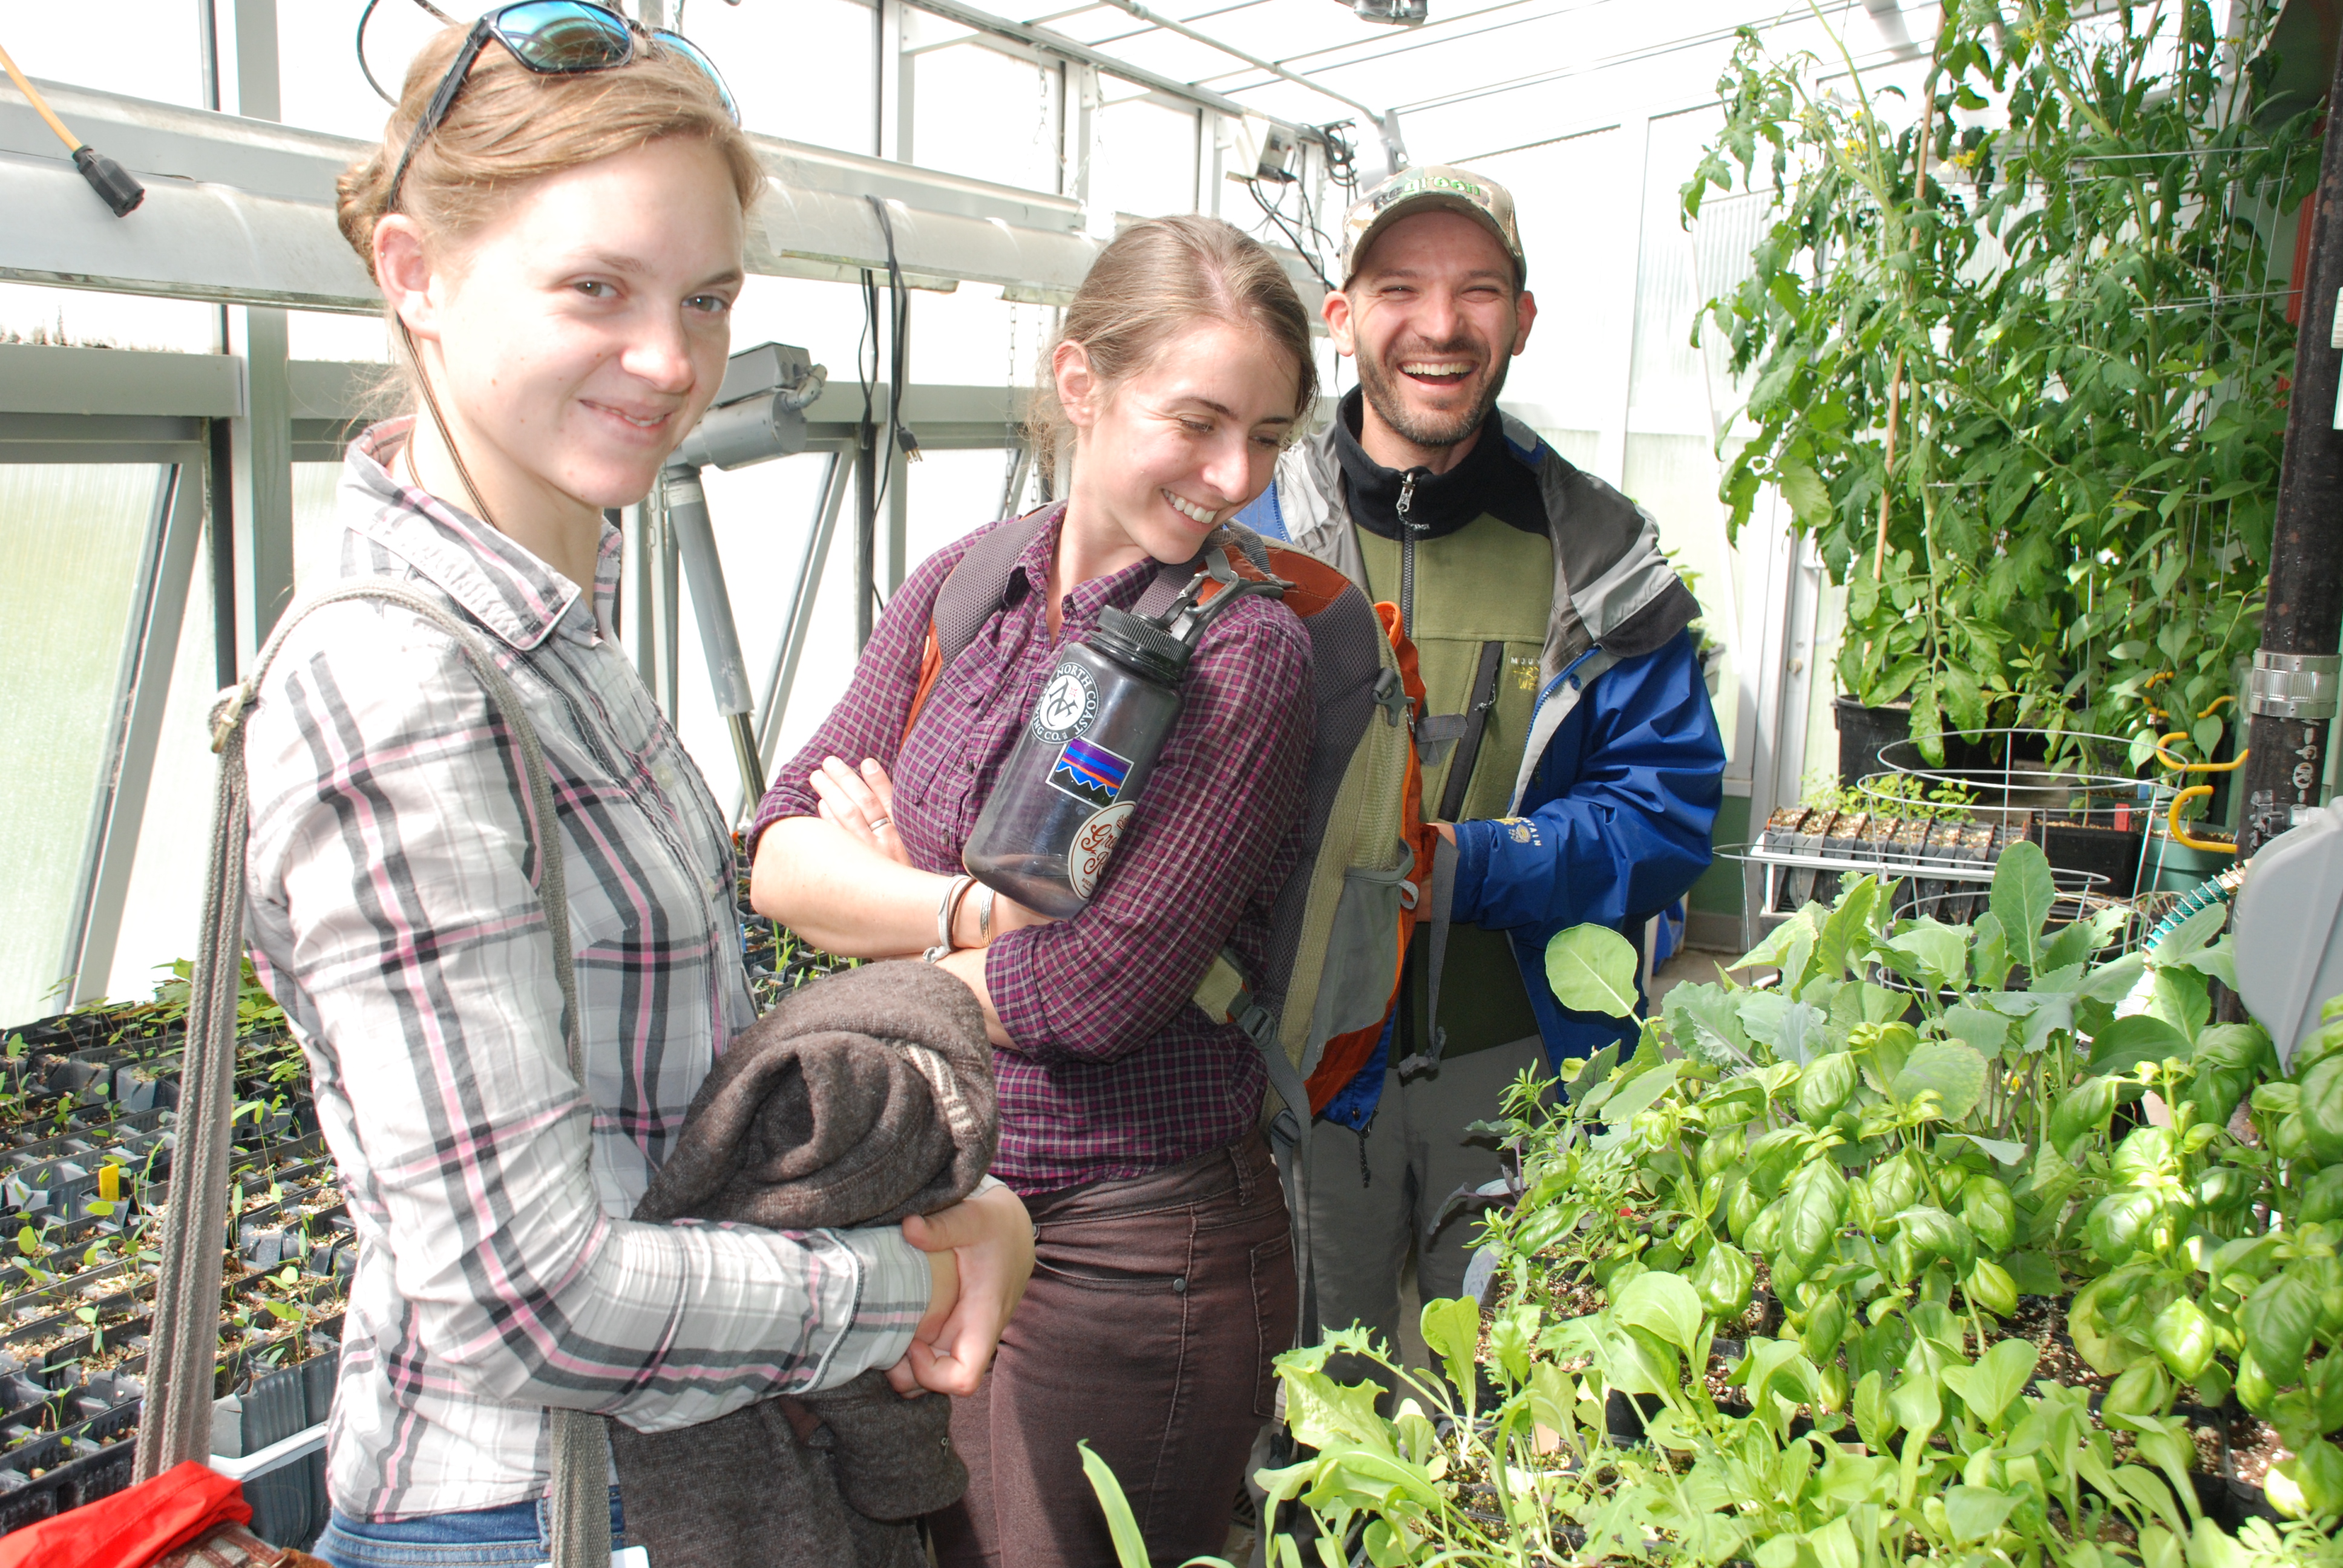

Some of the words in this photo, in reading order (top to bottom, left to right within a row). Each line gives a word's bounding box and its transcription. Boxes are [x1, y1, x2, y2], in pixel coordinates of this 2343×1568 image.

[1056, 664, 1093, 689] NORTH
[1073, 690, 1096, 735] COAST
[1044, 731, 1061, 741] CO.
[1081, 823, 1118, 855] Gre
